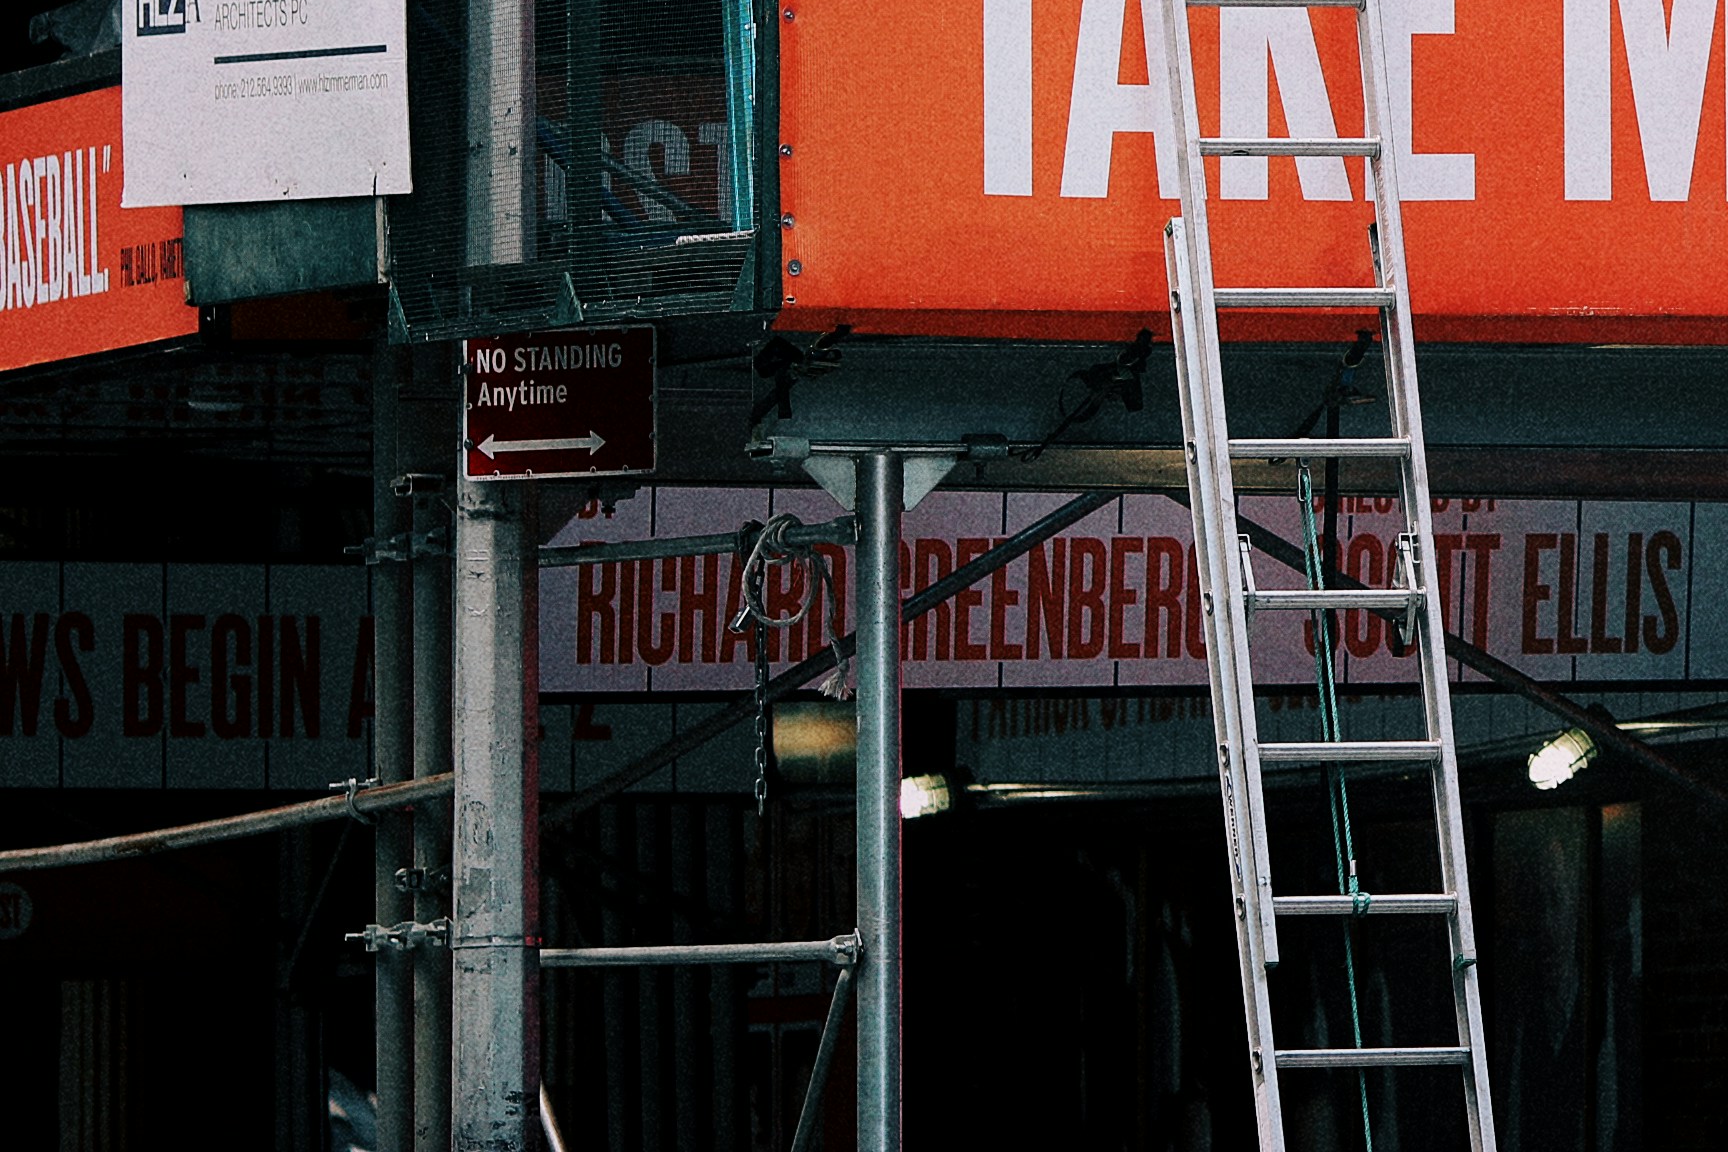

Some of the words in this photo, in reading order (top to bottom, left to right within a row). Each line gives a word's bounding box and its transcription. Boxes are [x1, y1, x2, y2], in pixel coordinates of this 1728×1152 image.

[476, 348, 507, 374] NO
[514, 343, 622, 372] STANDING
[477, 380, 568, 412] Anytime
[577, 540, 846, 665] RICHARD
[1522, 531, 1682, 656] ELLIS
[123, 614, 320, 739] BEGIN
